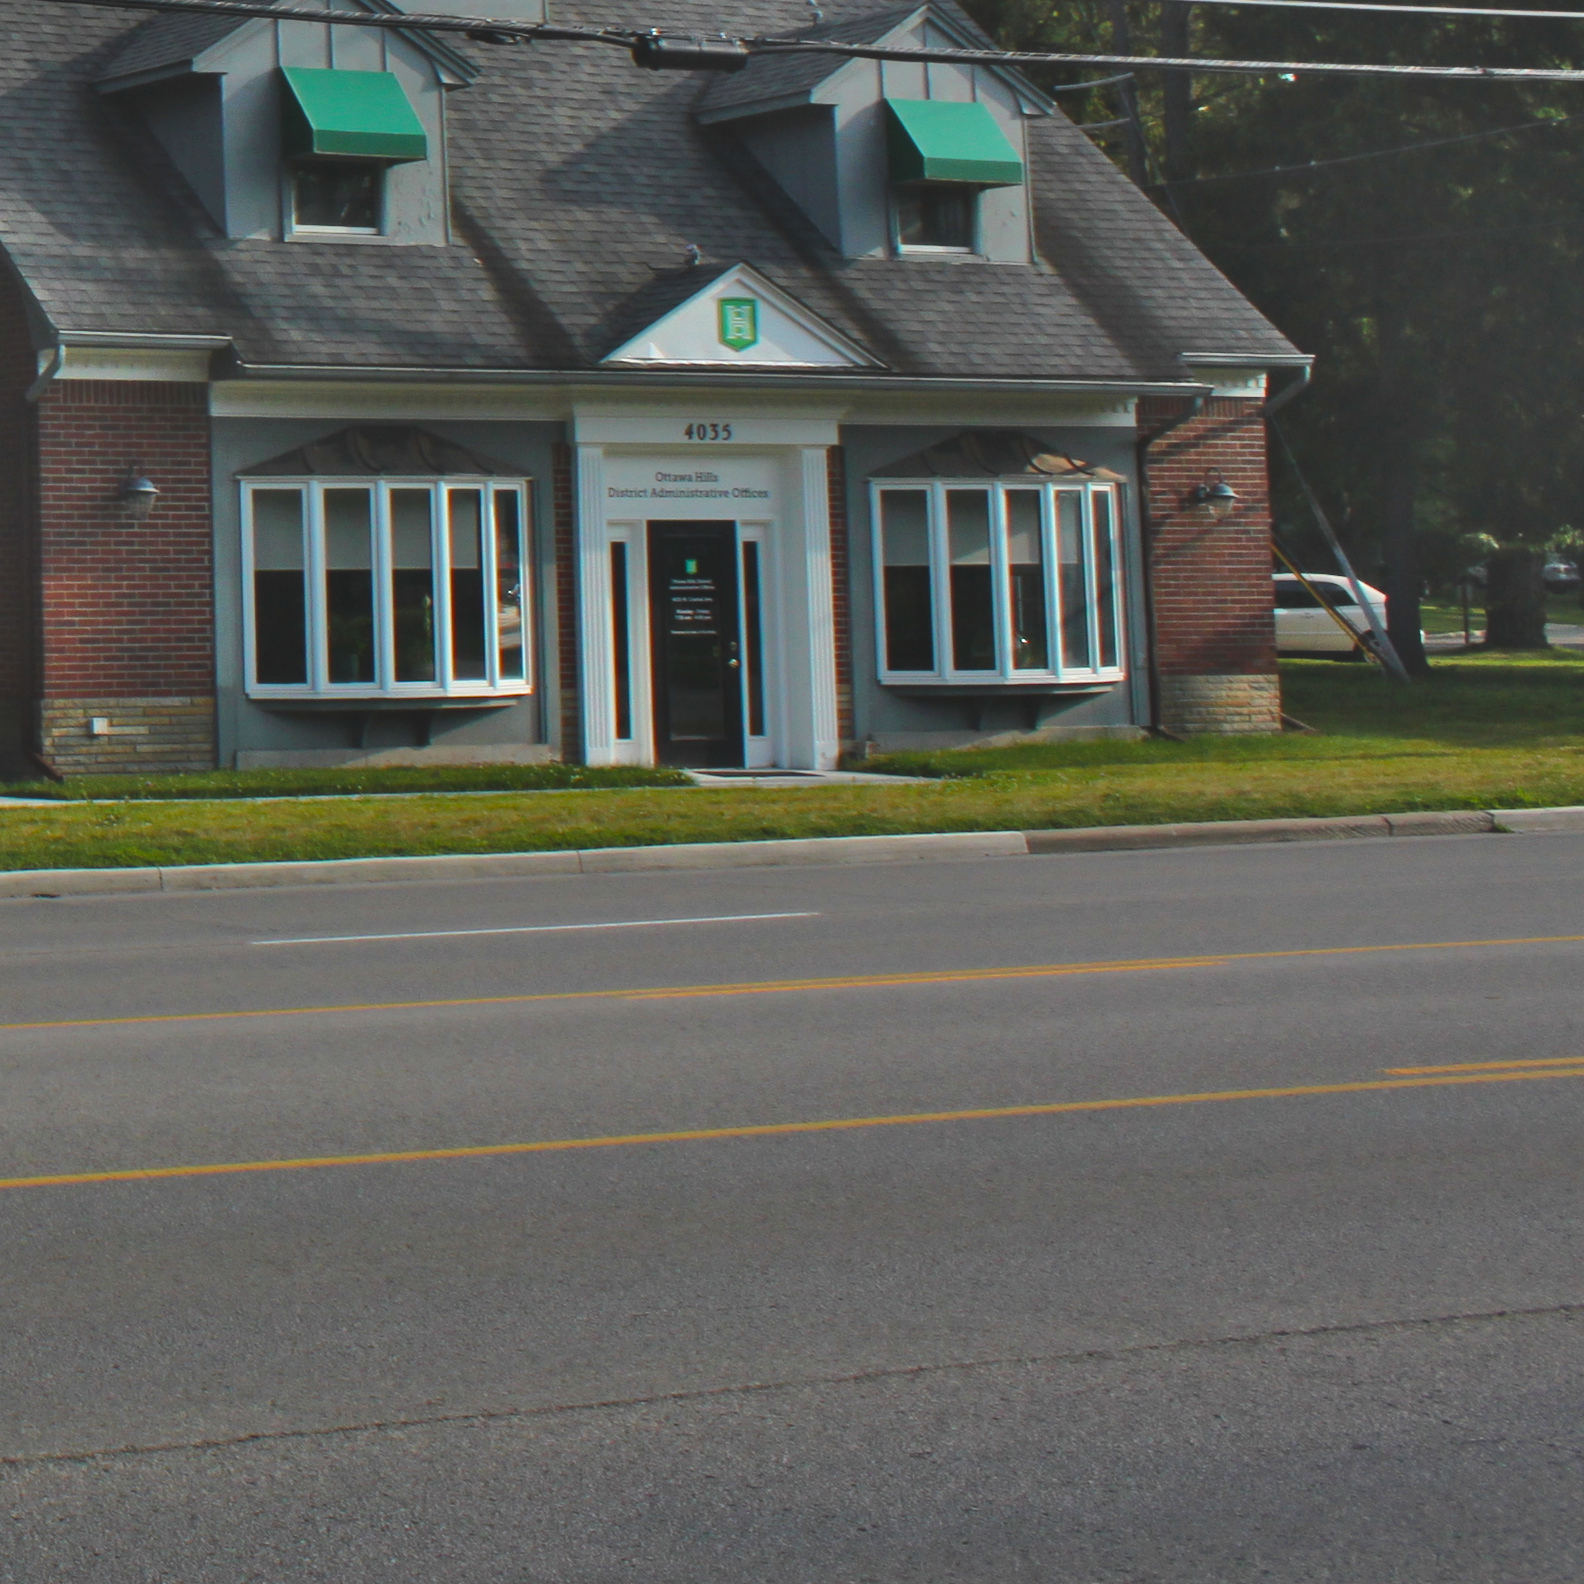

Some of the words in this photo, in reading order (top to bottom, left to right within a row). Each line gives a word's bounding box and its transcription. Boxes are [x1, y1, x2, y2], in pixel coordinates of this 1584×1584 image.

[683, 423, 732, 441] 4035
[655, 471, 693, 482] Ottawa
[695, 471, 720, 482] Hills
[607, 487, 648, 498] District
[650, 487, 729, 498] Administrative
[731, 487, 769, 498] Offices
